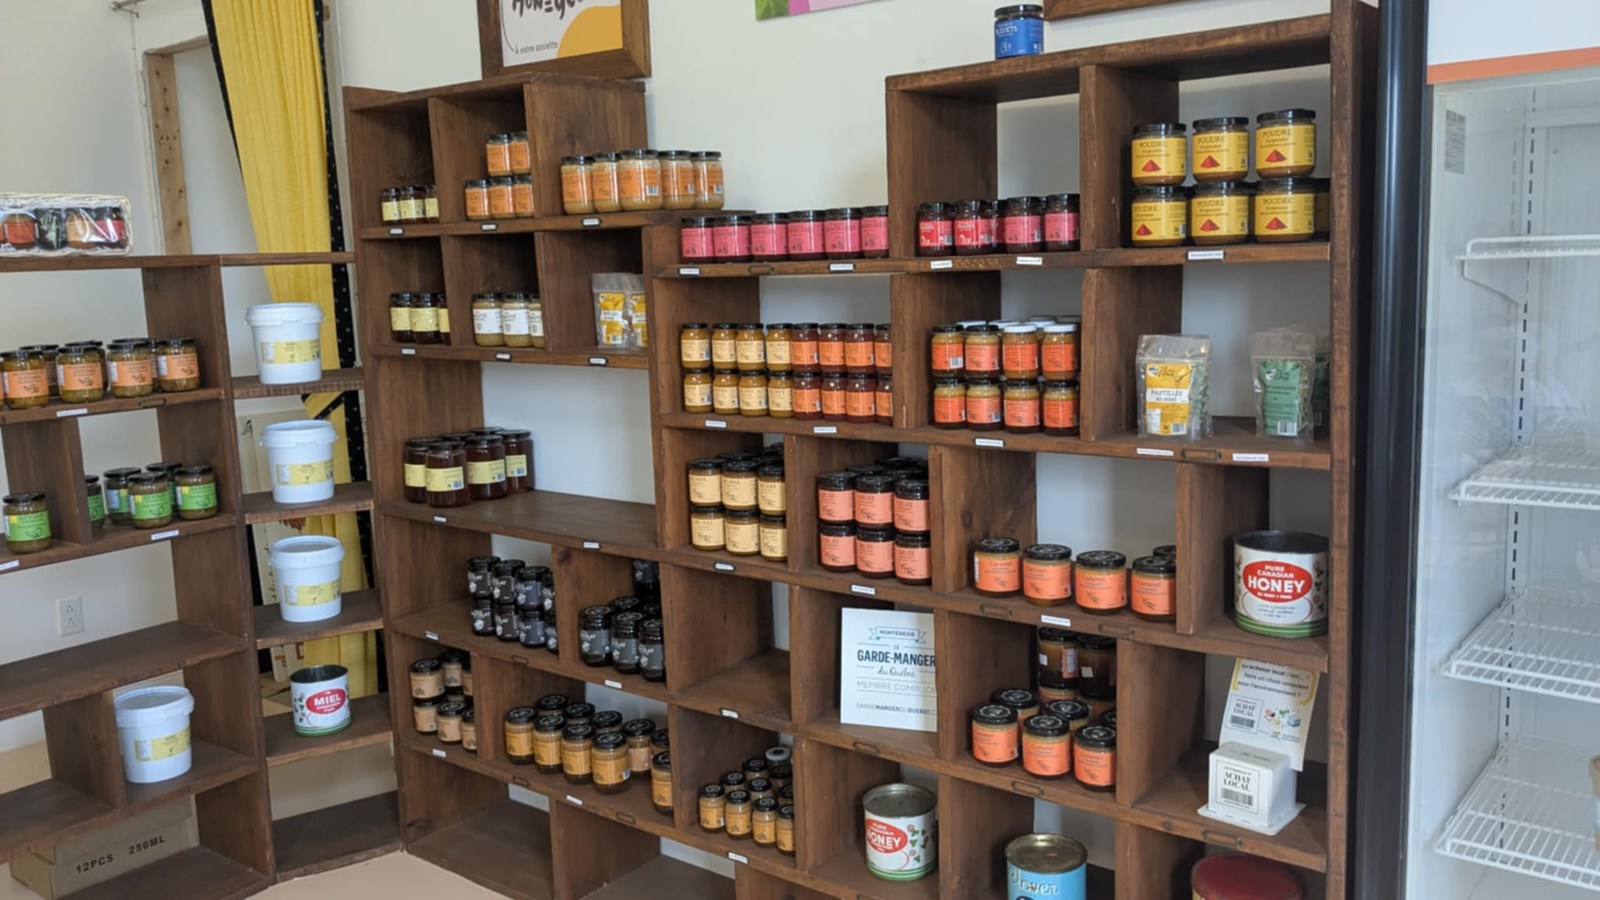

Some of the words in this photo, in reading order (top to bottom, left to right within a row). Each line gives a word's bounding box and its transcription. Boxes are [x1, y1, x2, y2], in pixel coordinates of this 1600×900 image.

[520, 44, 535, 54] votre
[536, 41, 558, 52] assiette
[1262, 129, 1292, 138] POUDRE
[1151, 389, 1183, 397] PASTILLES
[1257, 569, 1294, 579] CANADIAN
[1248, 574, 1305, 593] HONEY
[857, 649, 936, 667] GARDE-MANGER
[878, 665, 889, 675] du
[857, 680, 893, 691] MEMBRE
[313, 693, 342, 706] MIEL
[1233, 708, 1255, 718] LOCAL
[1235, 702, 1256, 712] ACHAT
[1224, 771, 1251, 784] ACHAT
[1223, 779, 1251, 792] LOCAL
[76, 853, 115, 874] 12PCS
[128, 835, 166, 856] 250ML
